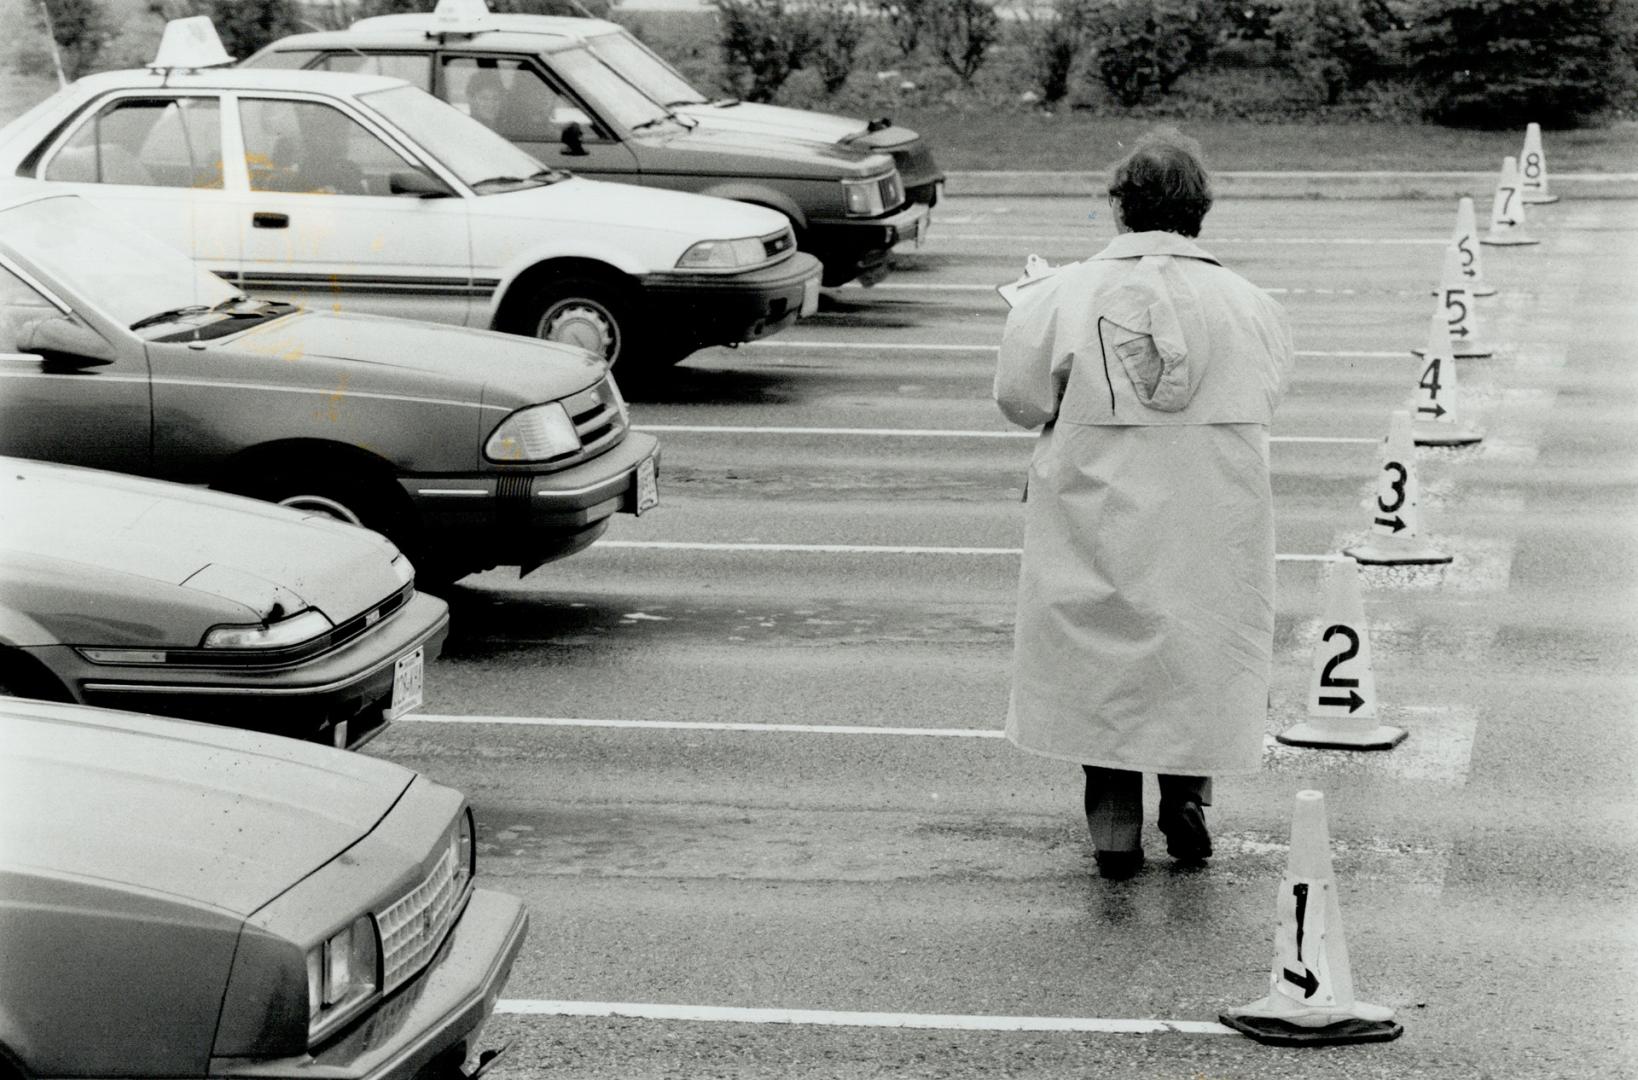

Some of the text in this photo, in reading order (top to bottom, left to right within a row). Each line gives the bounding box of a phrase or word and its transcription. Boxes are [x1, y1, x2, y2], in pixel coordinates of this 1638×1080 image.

[1524, 152, 1541, 179] 8
[1499, 186, 1516, 215] 7
[1445, 289, 1467, 326] 5
[1419, 357, 1442, 400] 4
[1377, 461, 1408, 514] 3
[1319, 624, 1360, 688] 2
[1292, 882, 1309, 963] 1
